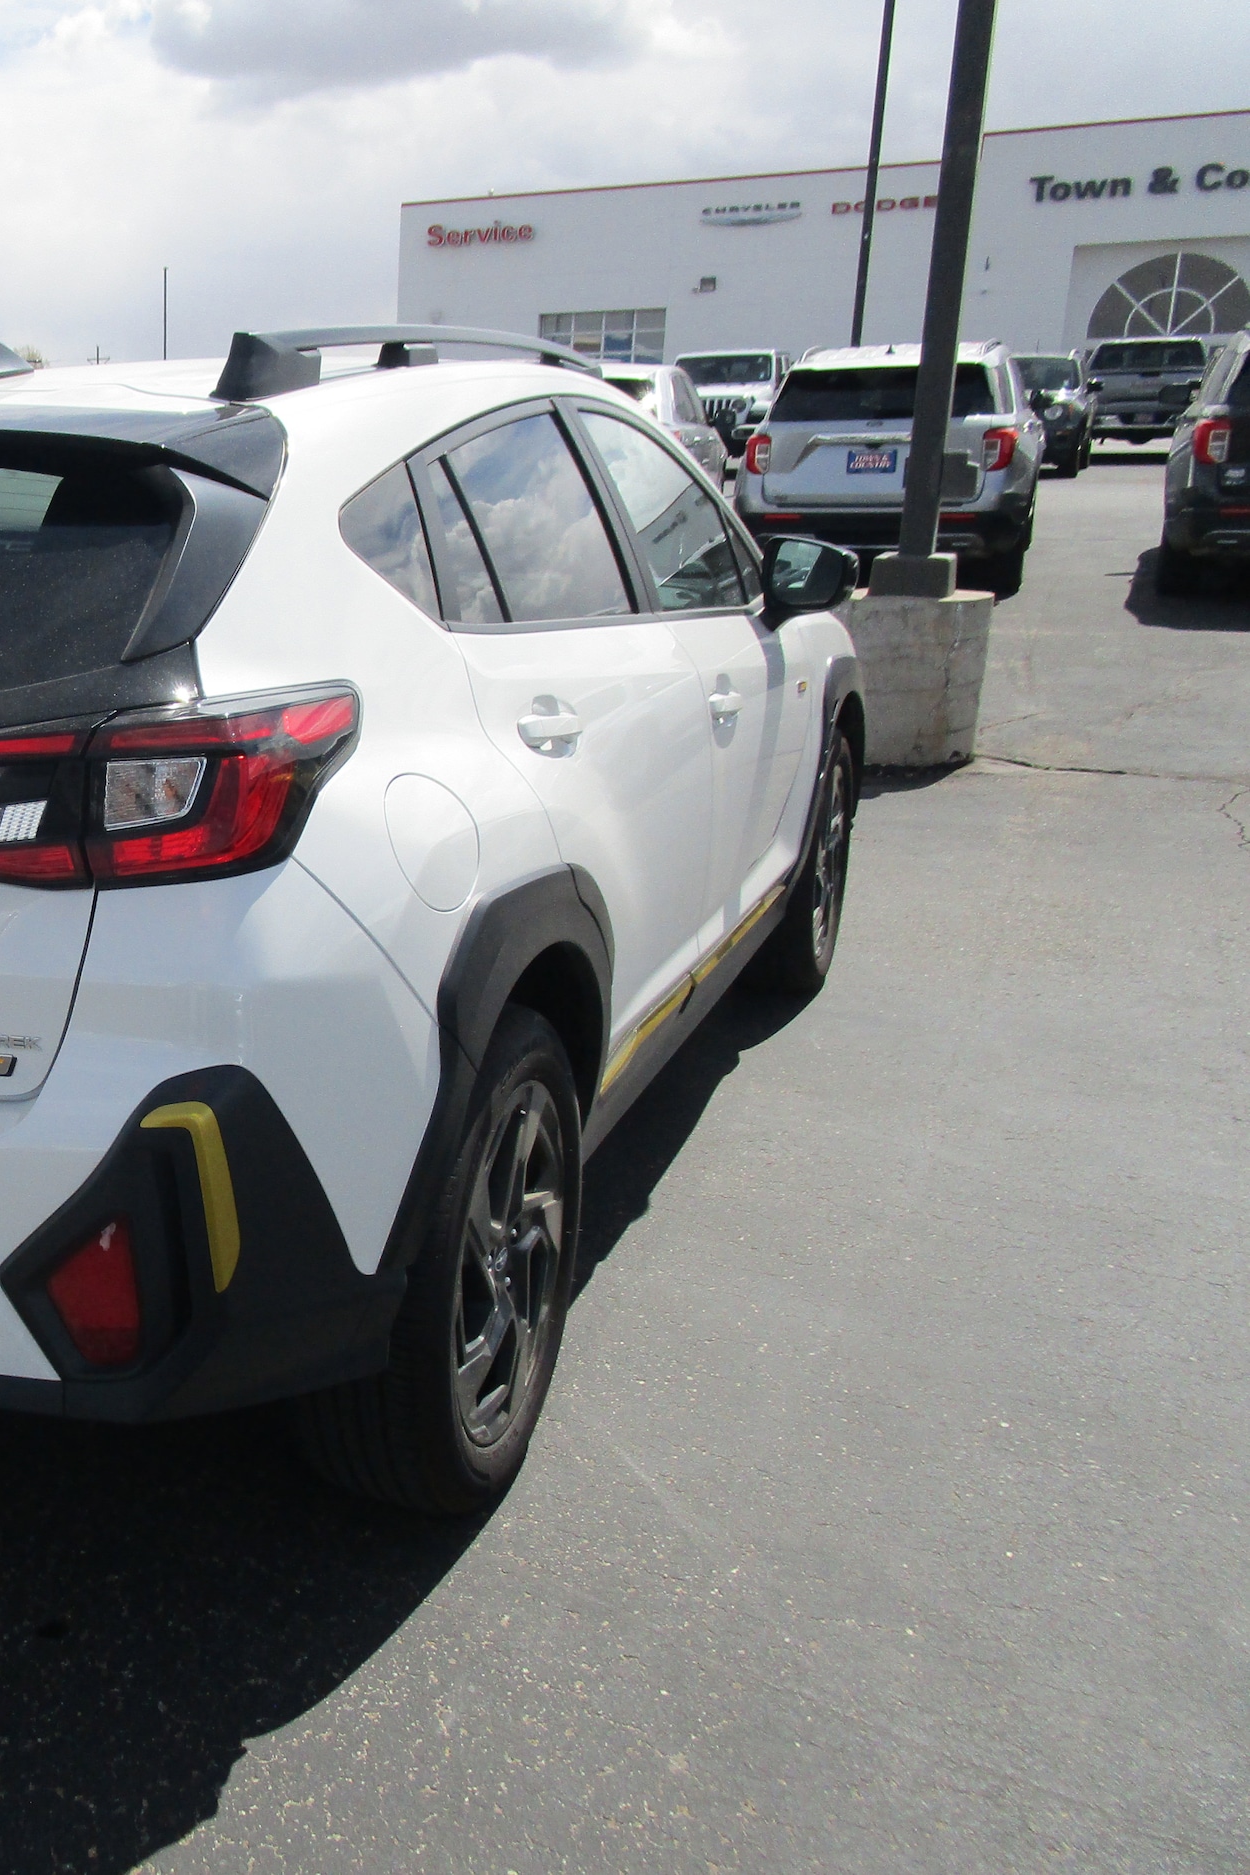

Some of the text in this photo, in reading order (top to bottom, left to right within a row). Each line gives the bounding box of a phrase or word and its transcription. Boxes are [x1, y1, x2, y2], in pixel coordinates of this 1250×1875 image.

[1030, 174, 1133, 203] Town
[1148, 166, 1180, 194] &
[831, 195, 938, 214] DODGE
[427, 220, 534, 247] Service
